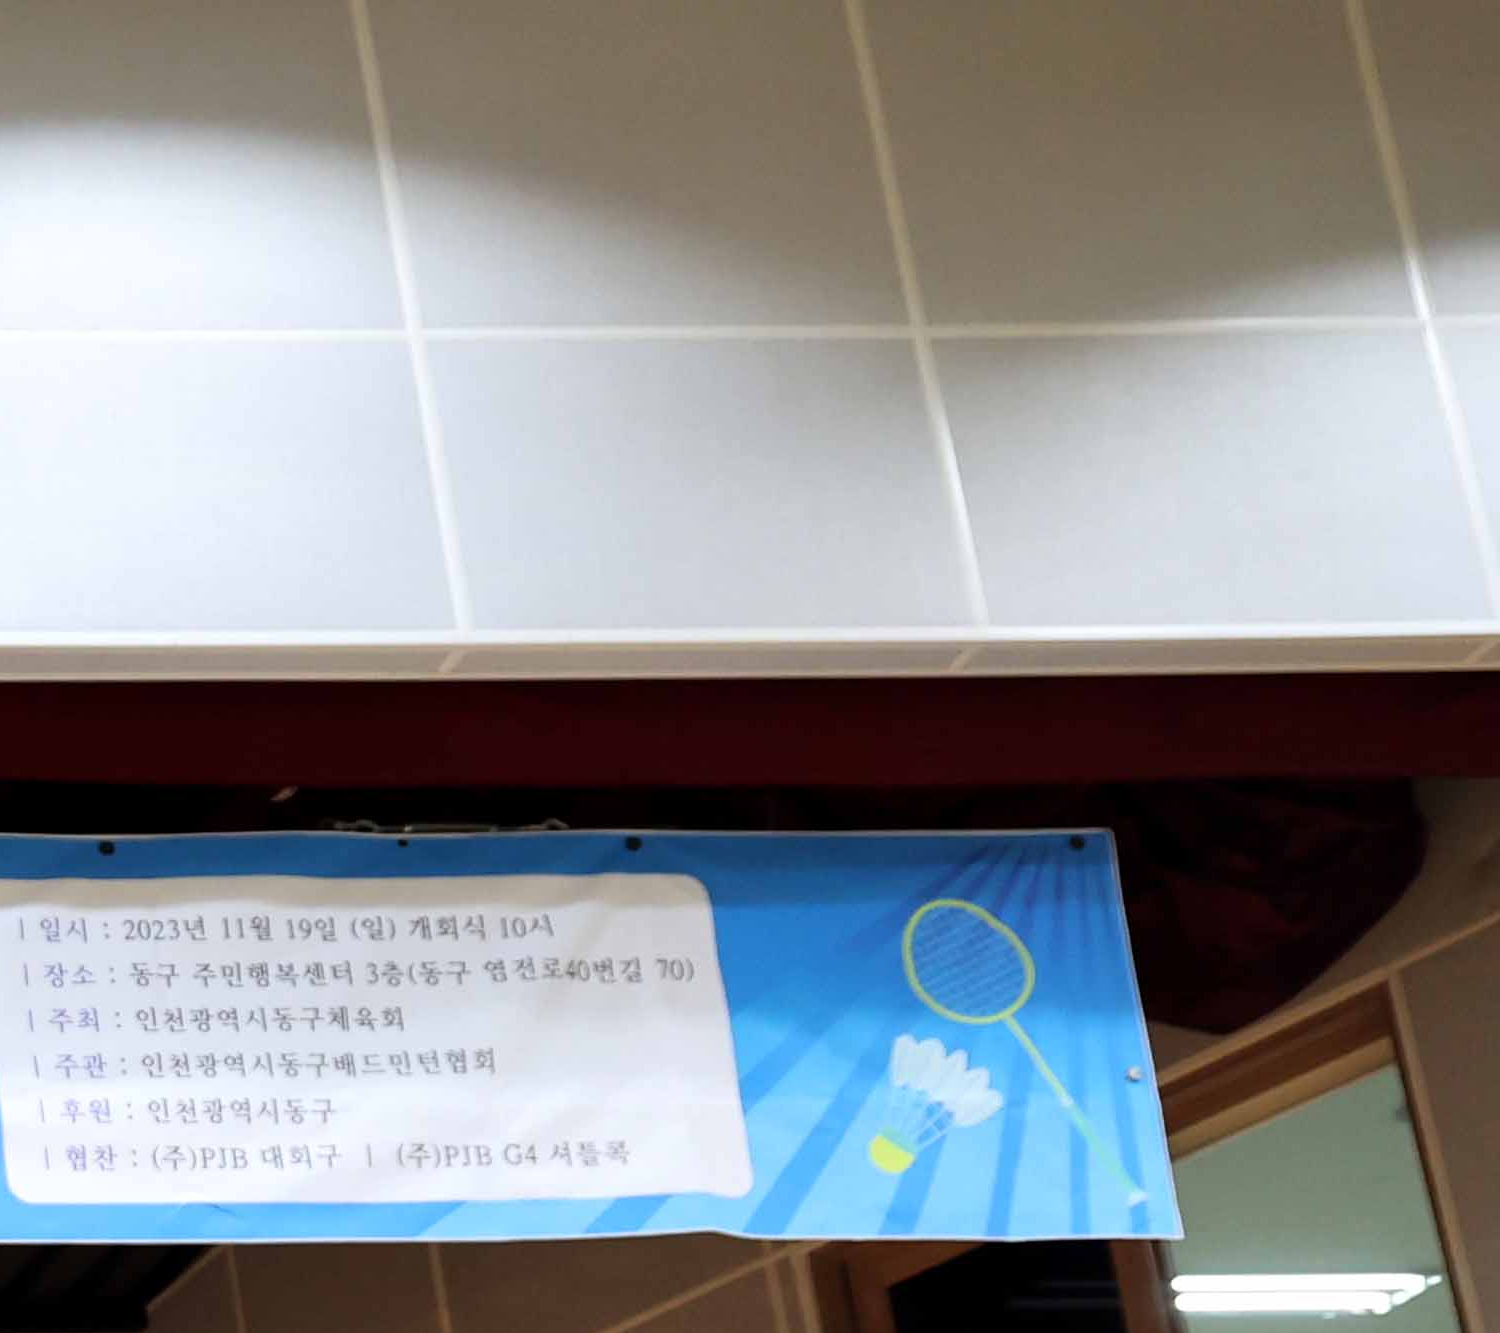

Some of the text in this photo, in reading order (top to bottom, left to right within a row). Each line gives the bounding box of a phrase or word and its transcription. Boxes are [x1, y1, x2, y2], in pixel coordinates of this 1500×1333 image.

[39, 916, 89, 943] 일시
[123, 916, 207, 943] 2023년
[221, 915, 273, 943] 11월
[286, 915, 338, 943] 19일
[349, 916, 396, 942] (일)
[407, 914, 486, 943] 개회식
[499, 913, 555, 940] 10시
[43, 961, 96, 989] 장소
[129, 961, 180, 988] 동구
[191, 960, 355, 989] 주민행복센터
[655, 957, 696, 984] 70)
[48, 1007, 101, 1034] 주최
[135, 1005, 406, 1034] 인천광역시동구체육회
[54, 1052, 108, 1080] 주관
[140, 1048, 498, 1080] 인천광역시동구배드민턴협회
[60, 1097, 113, 1125] 후원
[147, 1096, 338, 1126] 인천광역시동구
[66, 1143, 118, 1171] 협찬
[502, 1143, 541, 1167] G4
